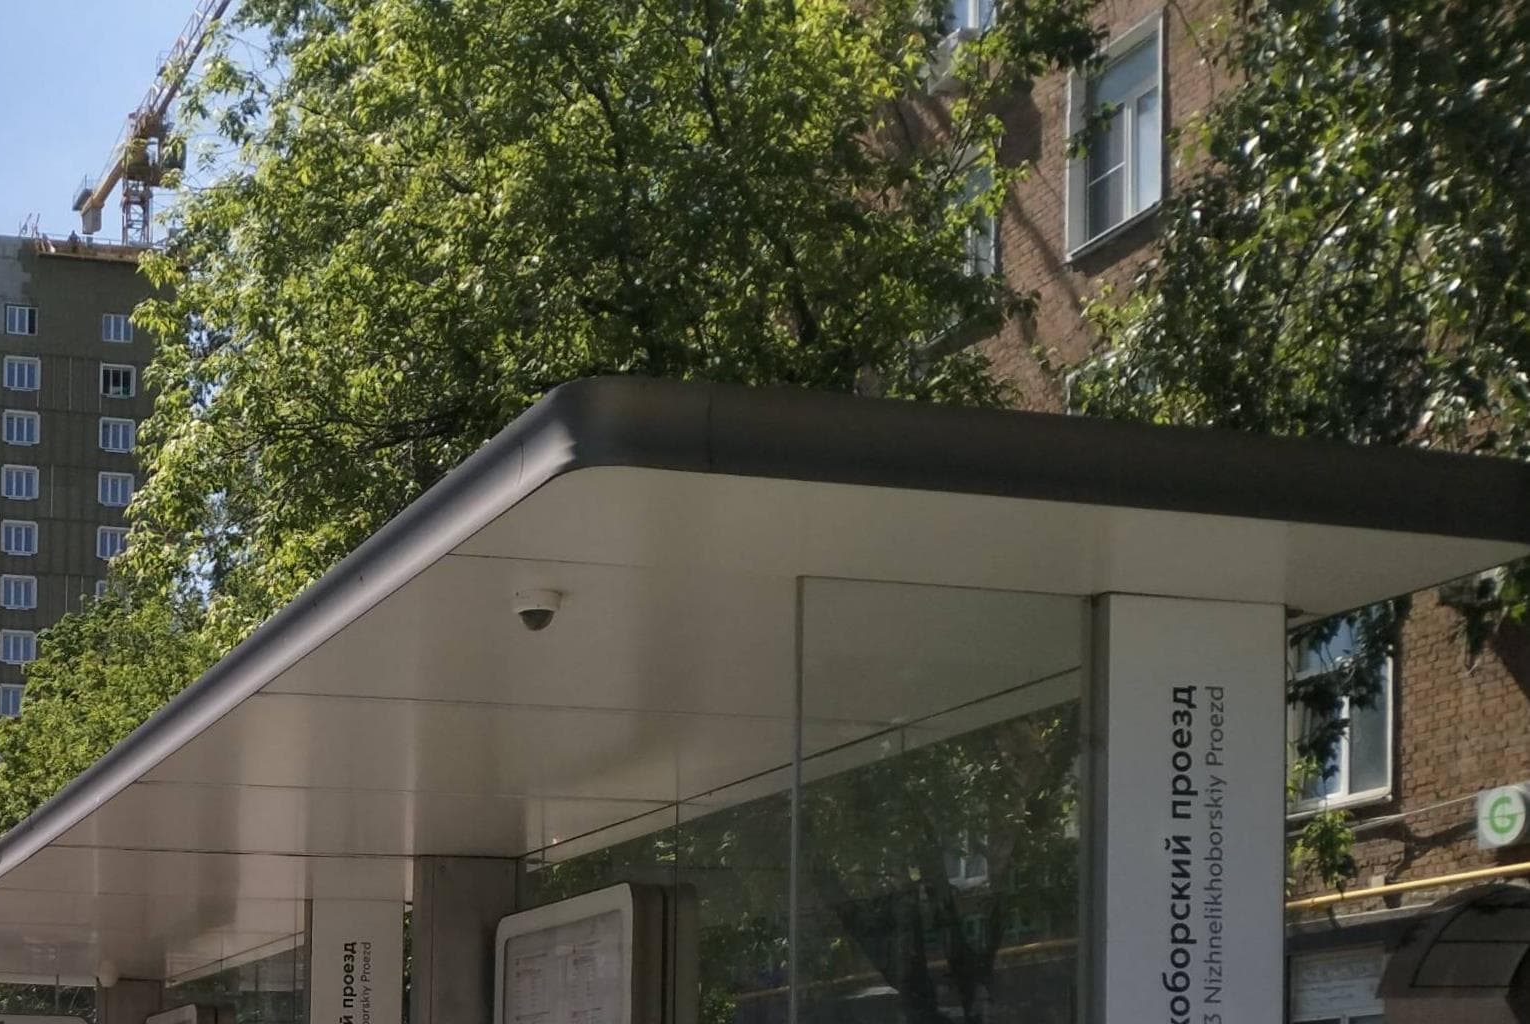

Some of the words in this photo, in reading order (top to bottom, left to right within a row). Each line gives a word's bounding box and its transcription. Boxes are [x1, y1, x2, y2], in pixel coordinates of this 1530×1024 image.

[1172, 685, 1199, 819] проезд
[1204, 686, 1224, 766] Proezd
[1203, 775, 1227, 1004] Nizhnelikhoborskiy
[342, 941, 357, 1008] проезд
[360, 941, 371, 983] Proezd
